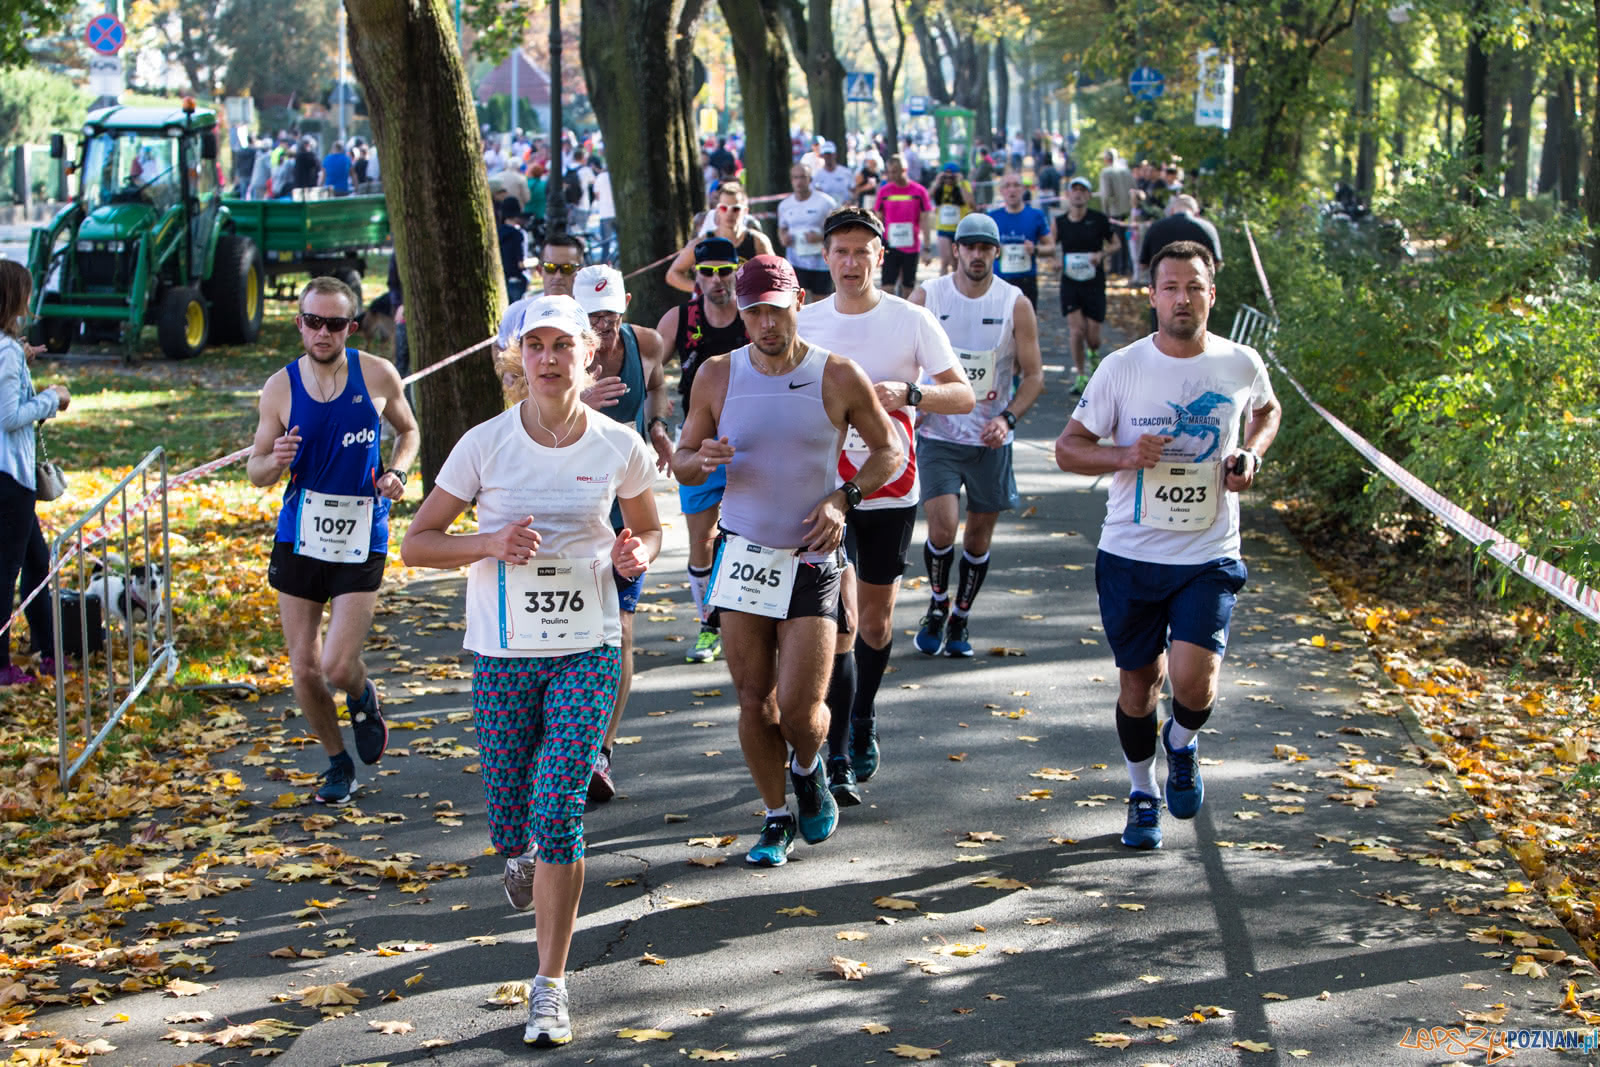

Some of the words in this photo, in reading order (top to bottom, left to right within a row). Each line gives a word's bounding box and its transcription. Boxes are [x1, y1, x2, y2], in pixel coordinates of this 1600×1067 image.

[1188, 416, 1220, 426] MARATON
[342, 428, 376, 448] pdo
[1155, 486, 1207, 503] 4023
[314, 516, 357, 536] 1097
[729, 562, 781, 587] 2045
[741, 585, 761, 594] Marcin
[525, 590, 584, 613] 3376
